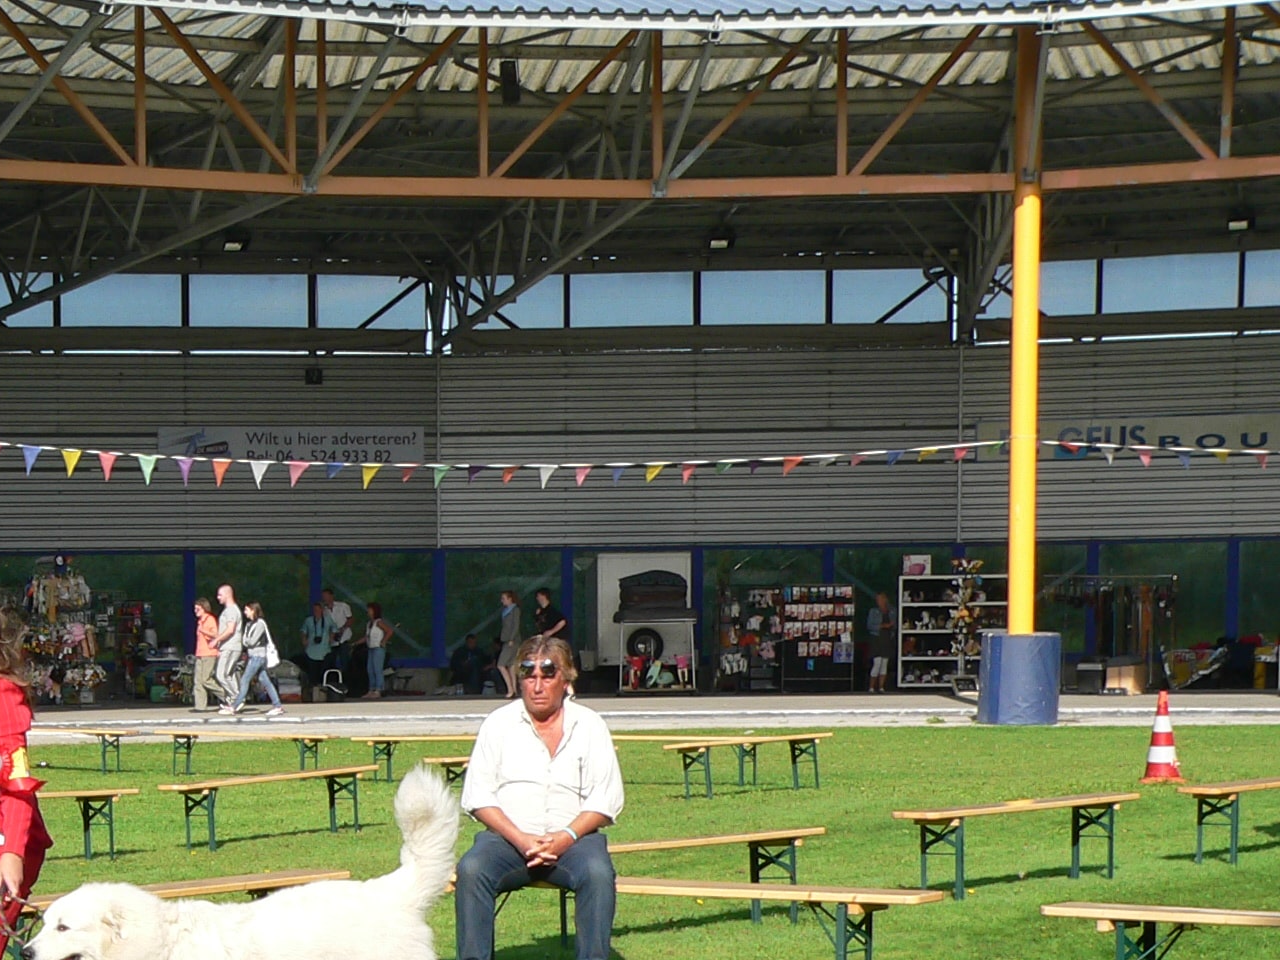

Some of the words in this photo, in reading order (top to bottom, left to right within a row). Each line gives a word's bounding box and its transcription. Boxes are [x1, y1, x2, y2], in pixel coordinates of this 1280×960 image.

[245, 432, 278, 446] Wilt
[284, 435, 292, 446] u
[298, 431, 326, 446] hier
[331, 431, 417, 446] adverteren?
[276, 449, 294, 462] 06
[311, 449, 337, 463] 524
[342, 449, 368, 463] 933
[374, 449, 391, 463] 82
